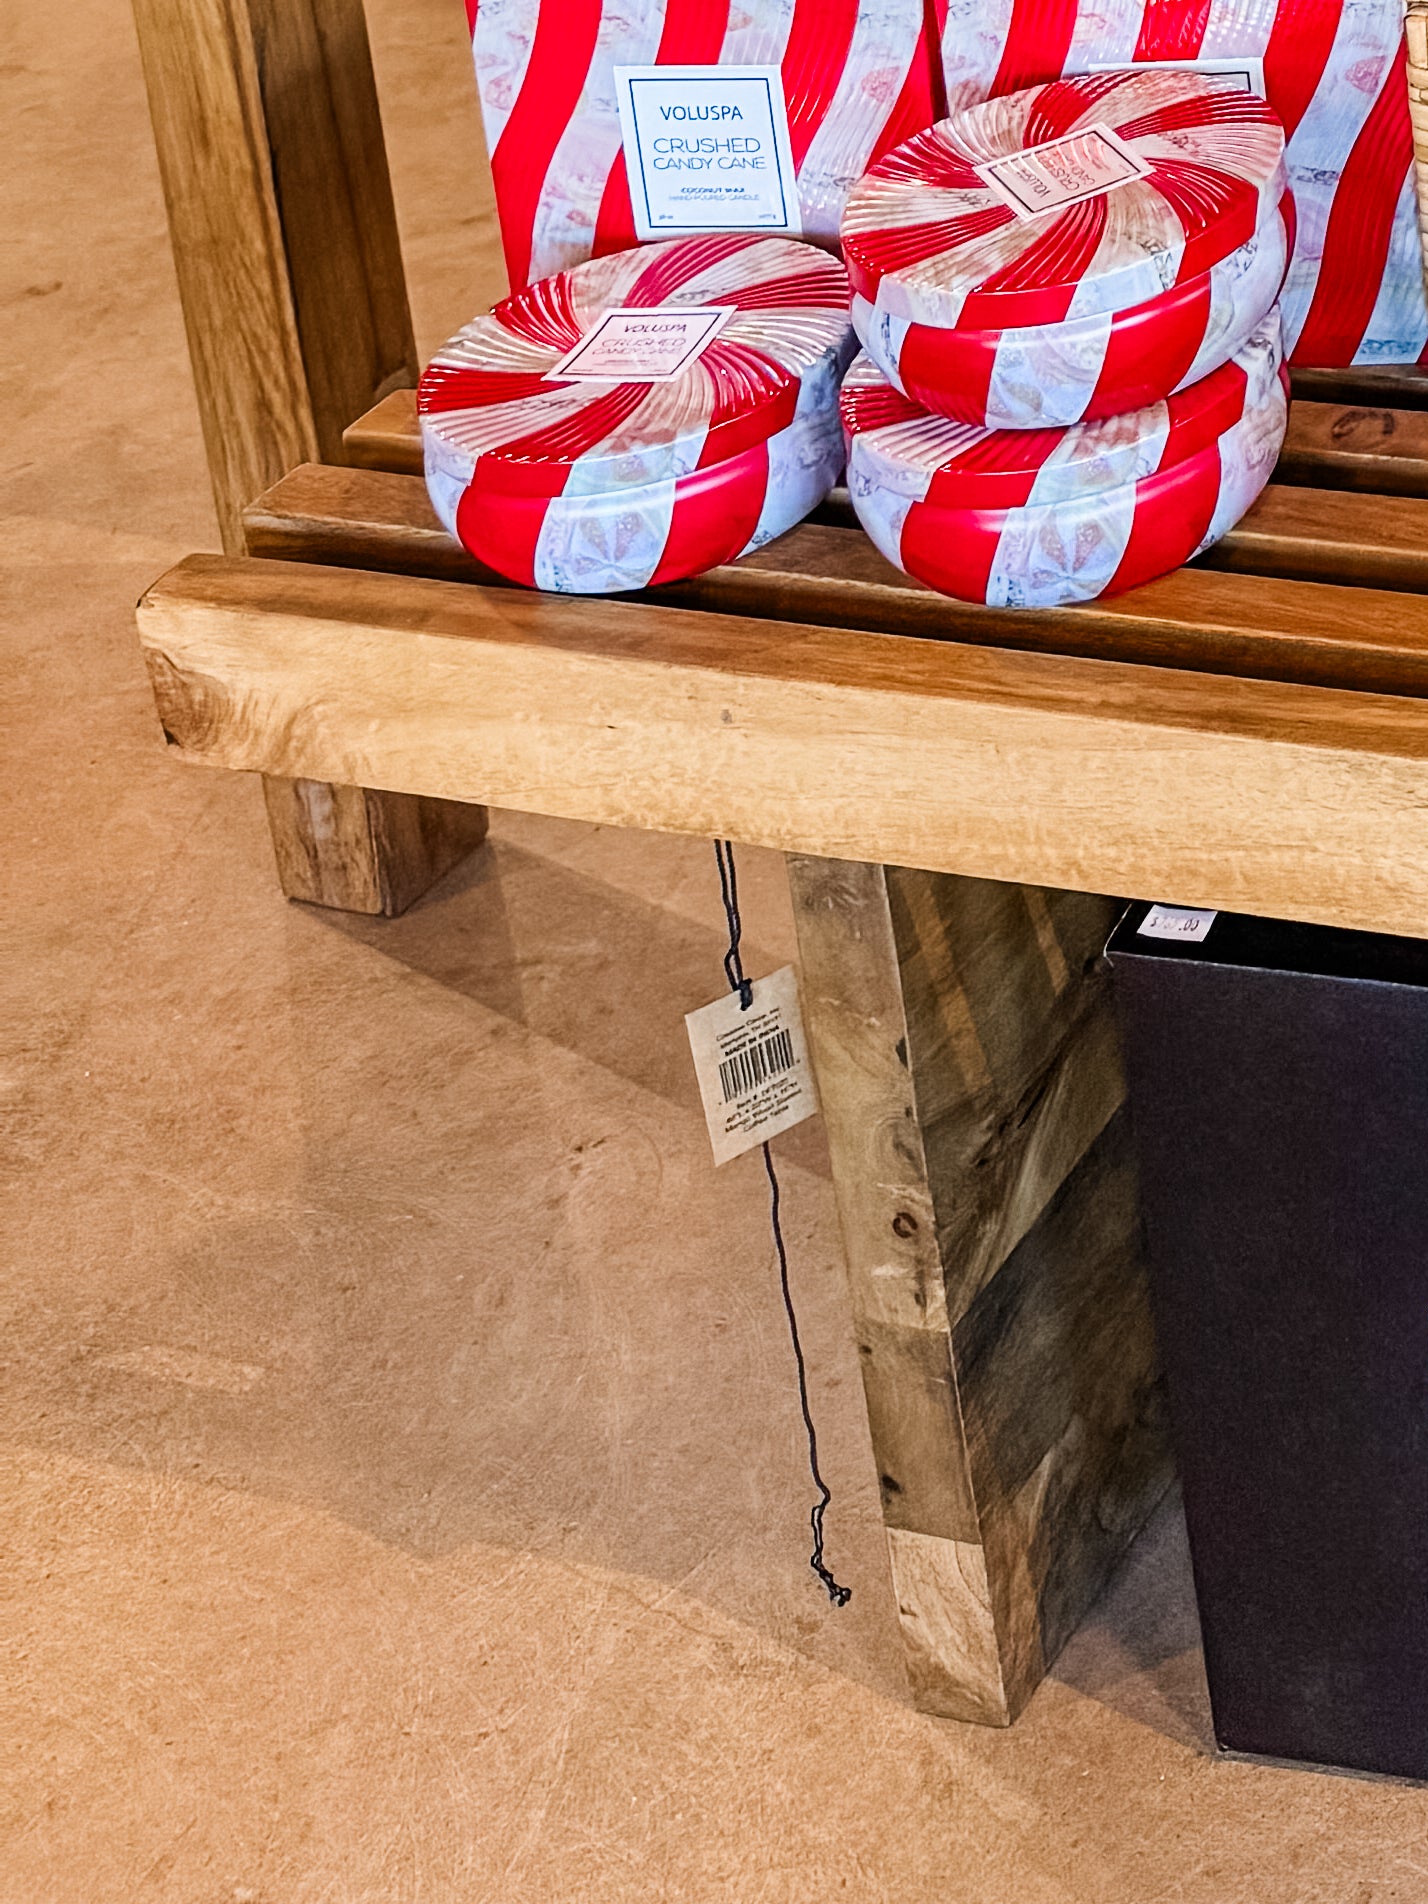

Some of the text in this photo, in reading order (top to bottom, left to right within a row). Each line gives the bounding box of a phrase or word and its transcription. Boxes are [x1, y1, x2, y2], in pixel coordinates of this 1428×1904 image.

[660, 106, 743, 120] VOLUSPA
[653, 138, 760, 153] CRUSHED
[653, 157, 767, 170] CANDY CANE
[625, 324, 687, 332] VOLUSPA
